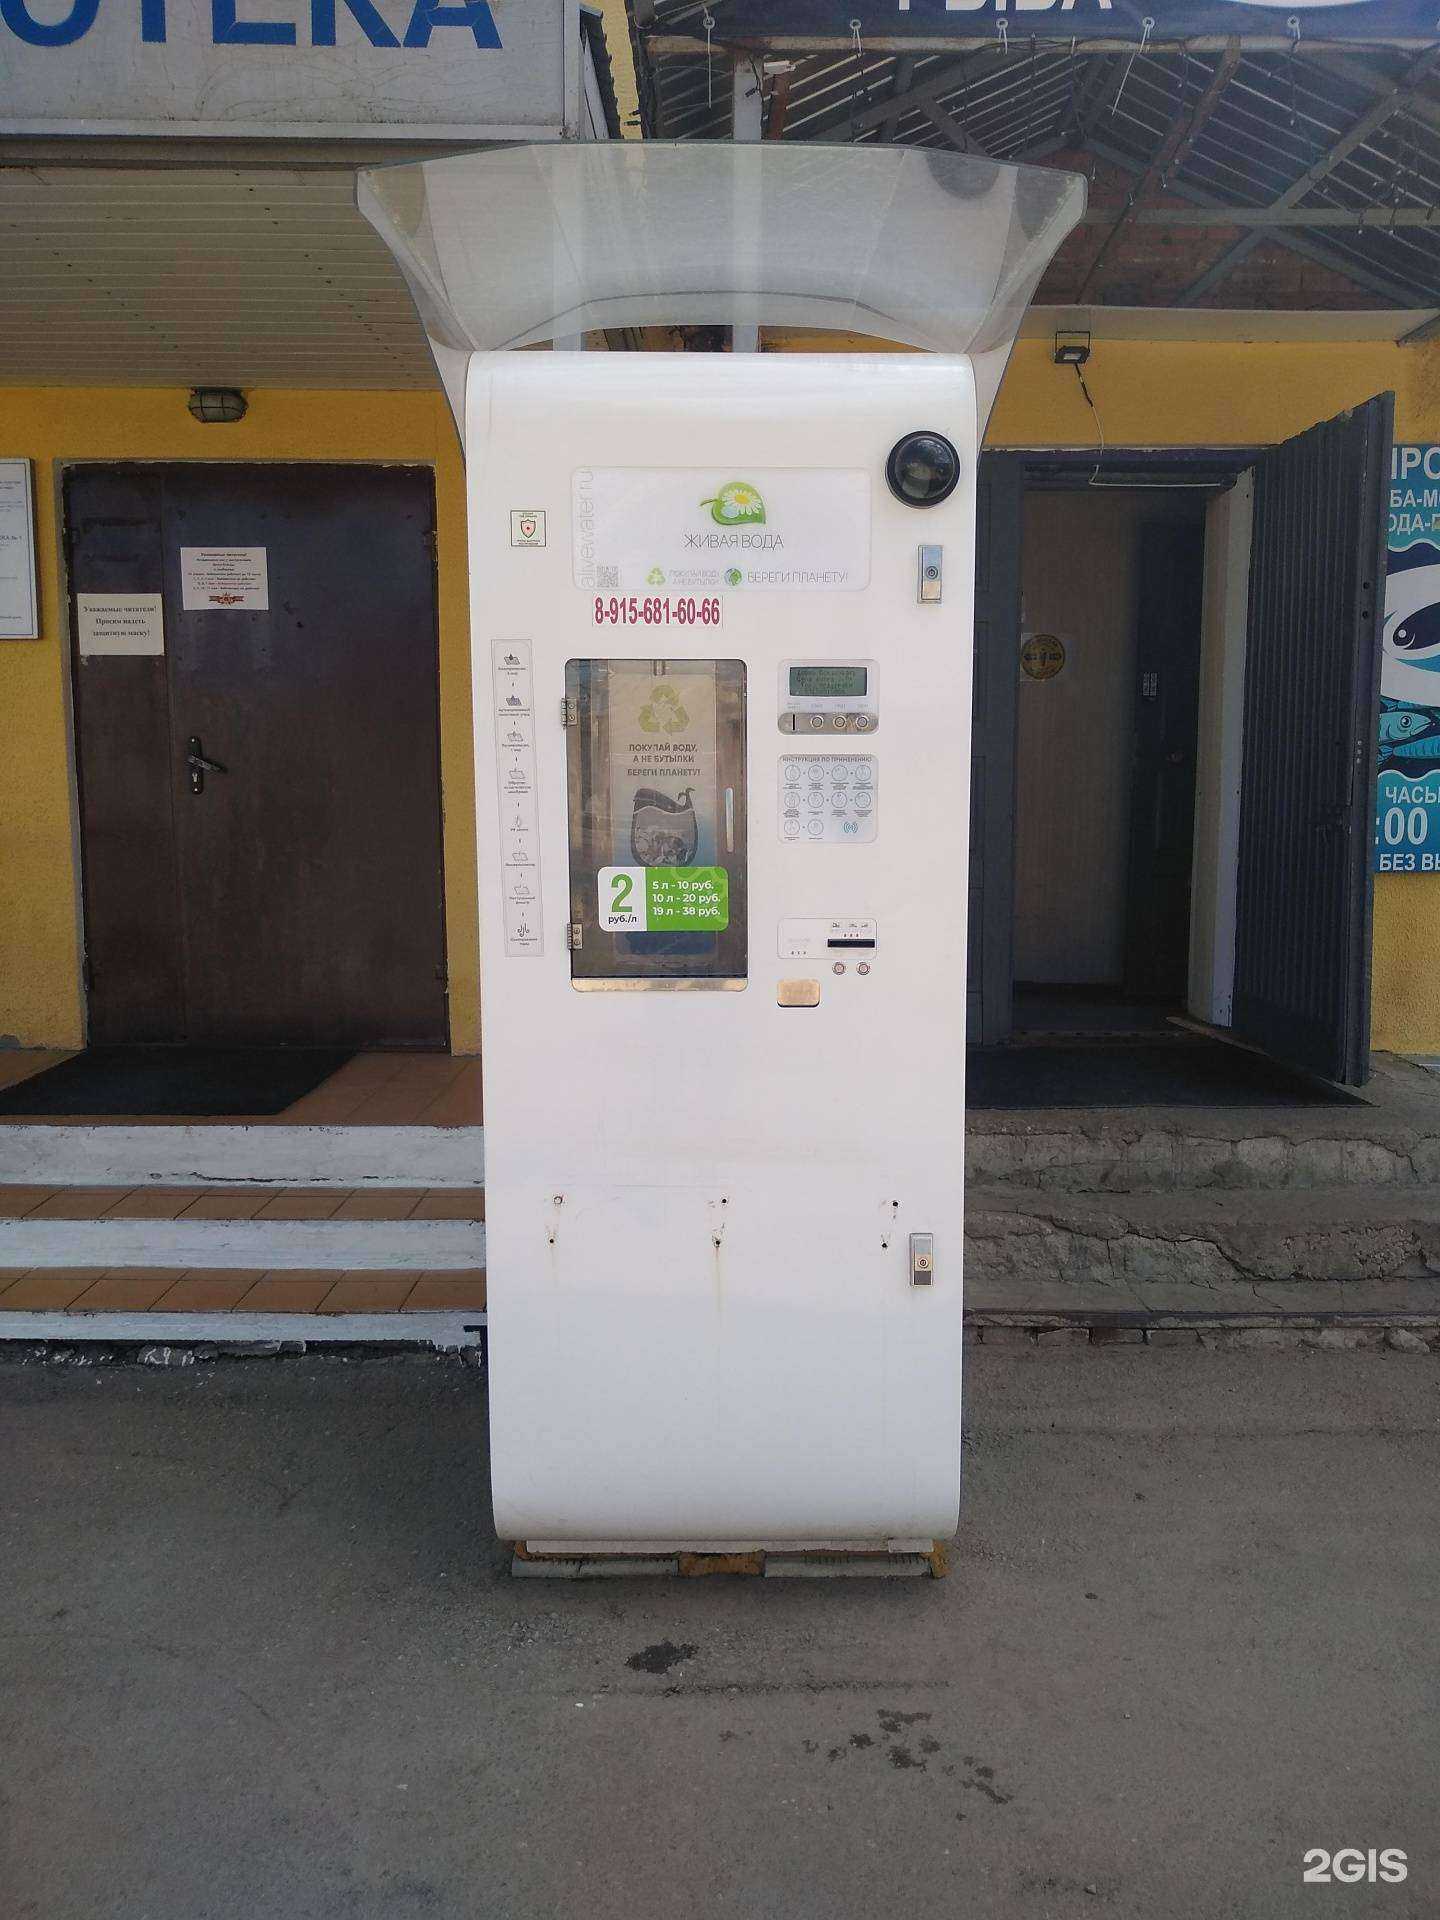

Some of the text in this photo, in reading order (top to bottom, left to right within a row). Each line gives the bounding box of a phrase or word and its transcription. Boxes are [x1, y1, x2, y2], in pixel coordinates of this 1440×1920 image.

[1390, 489, 1440, 507] БА-М
[684, 534, 784, 551] ЖИВАЯ ВОДА
[747, 571, 789, 583] БЕРЕГИ
[595, 597, 720, 625] 8-915-681-60-66
[629, 742, 671, 751] ПОКУПАЙ
[633, 754, 639, 762] А
[641, 754, 652, 762] НЕ
[627, 768, 657, 776] БЕРЕГИ
[1379, 853, 1415, 870] БЕЗ
[652, 881, 659, 890] 5
[677, 881, 689, 890] 10
[691, 880, 714, 891] руб.
[611, 873, 633, 912] 2
[652, 893, 664, 903] 10
[666, 895, 673, 903] л
[682, 893, 696, 903] 20
[698, 893, 721, 904] руб.
[652, 906, 664, 916] 19
[666, 908, 673, 916] л
[682, 906, 695, 916] 38
[698, 906, 721, 917] руб.
[608, 914, 637, 925] руб./л
